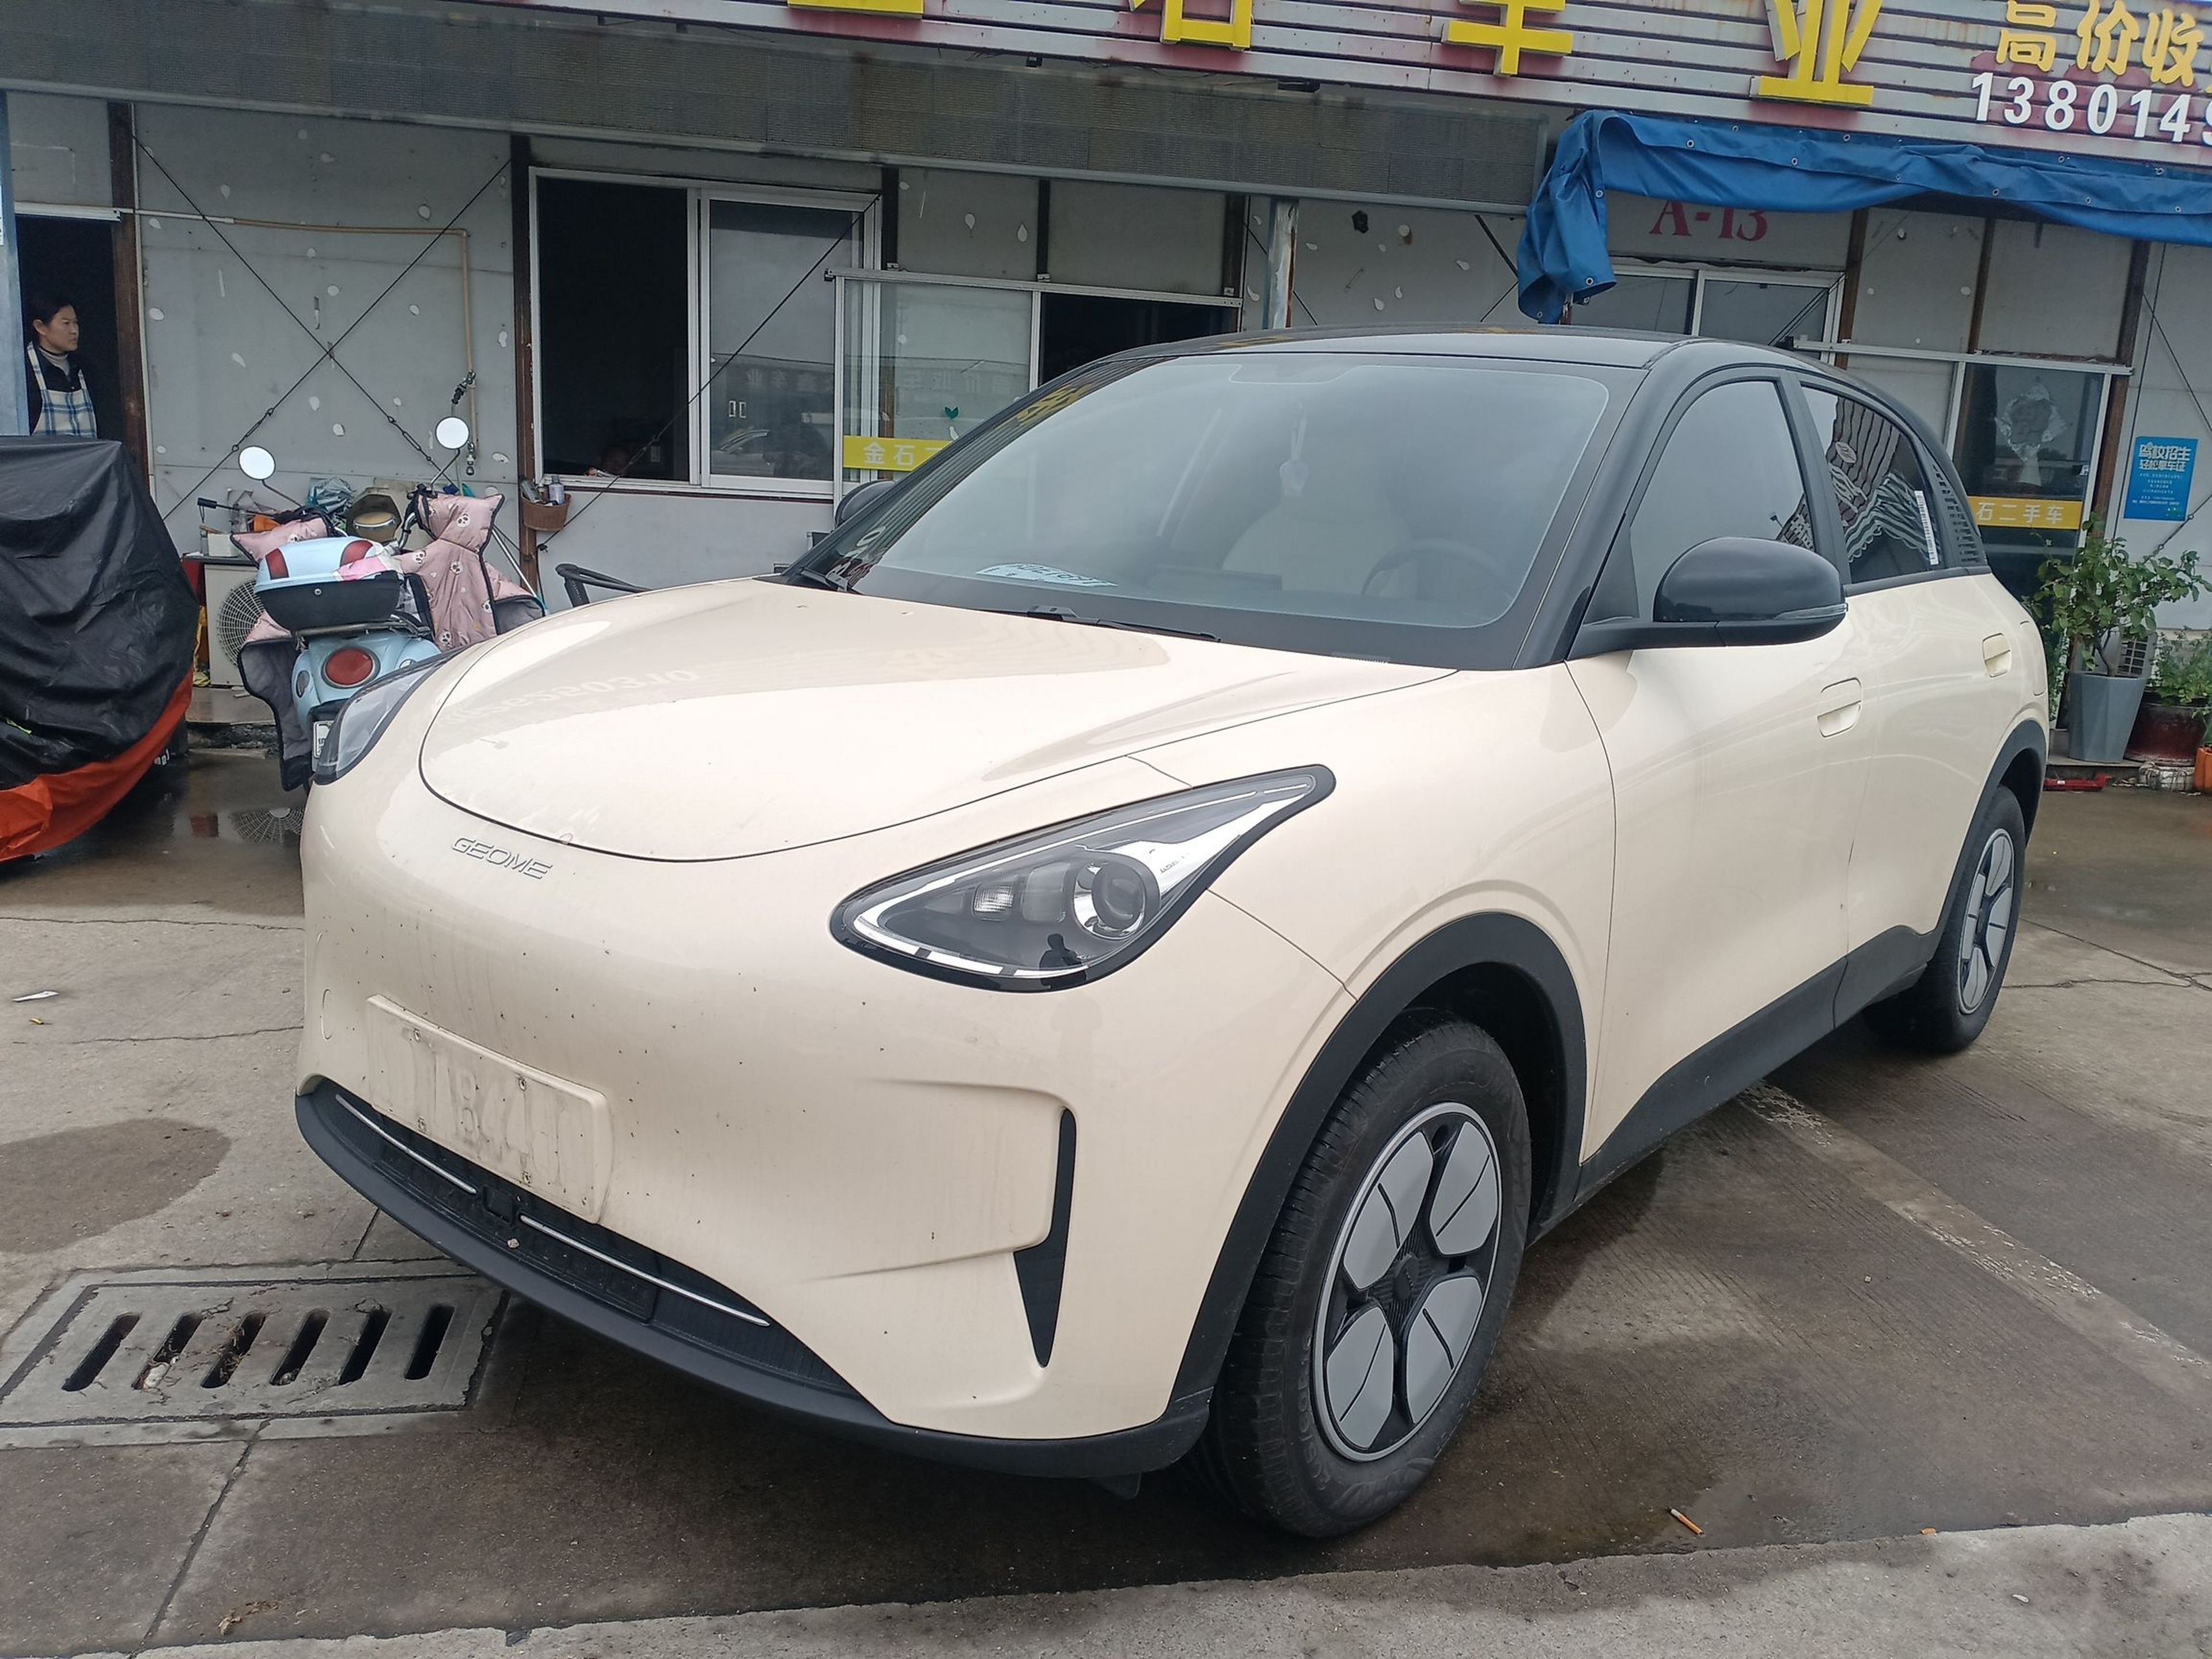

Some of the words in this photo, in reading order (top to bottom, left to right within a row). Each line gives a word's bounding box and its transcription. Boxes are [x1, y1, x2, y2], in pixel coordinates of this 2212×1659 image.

[1996, 0, 2212, 94] 高价收
[1977, 501, 2064, 524] 石二手车
[452, 837, 553, 879] GEOME
